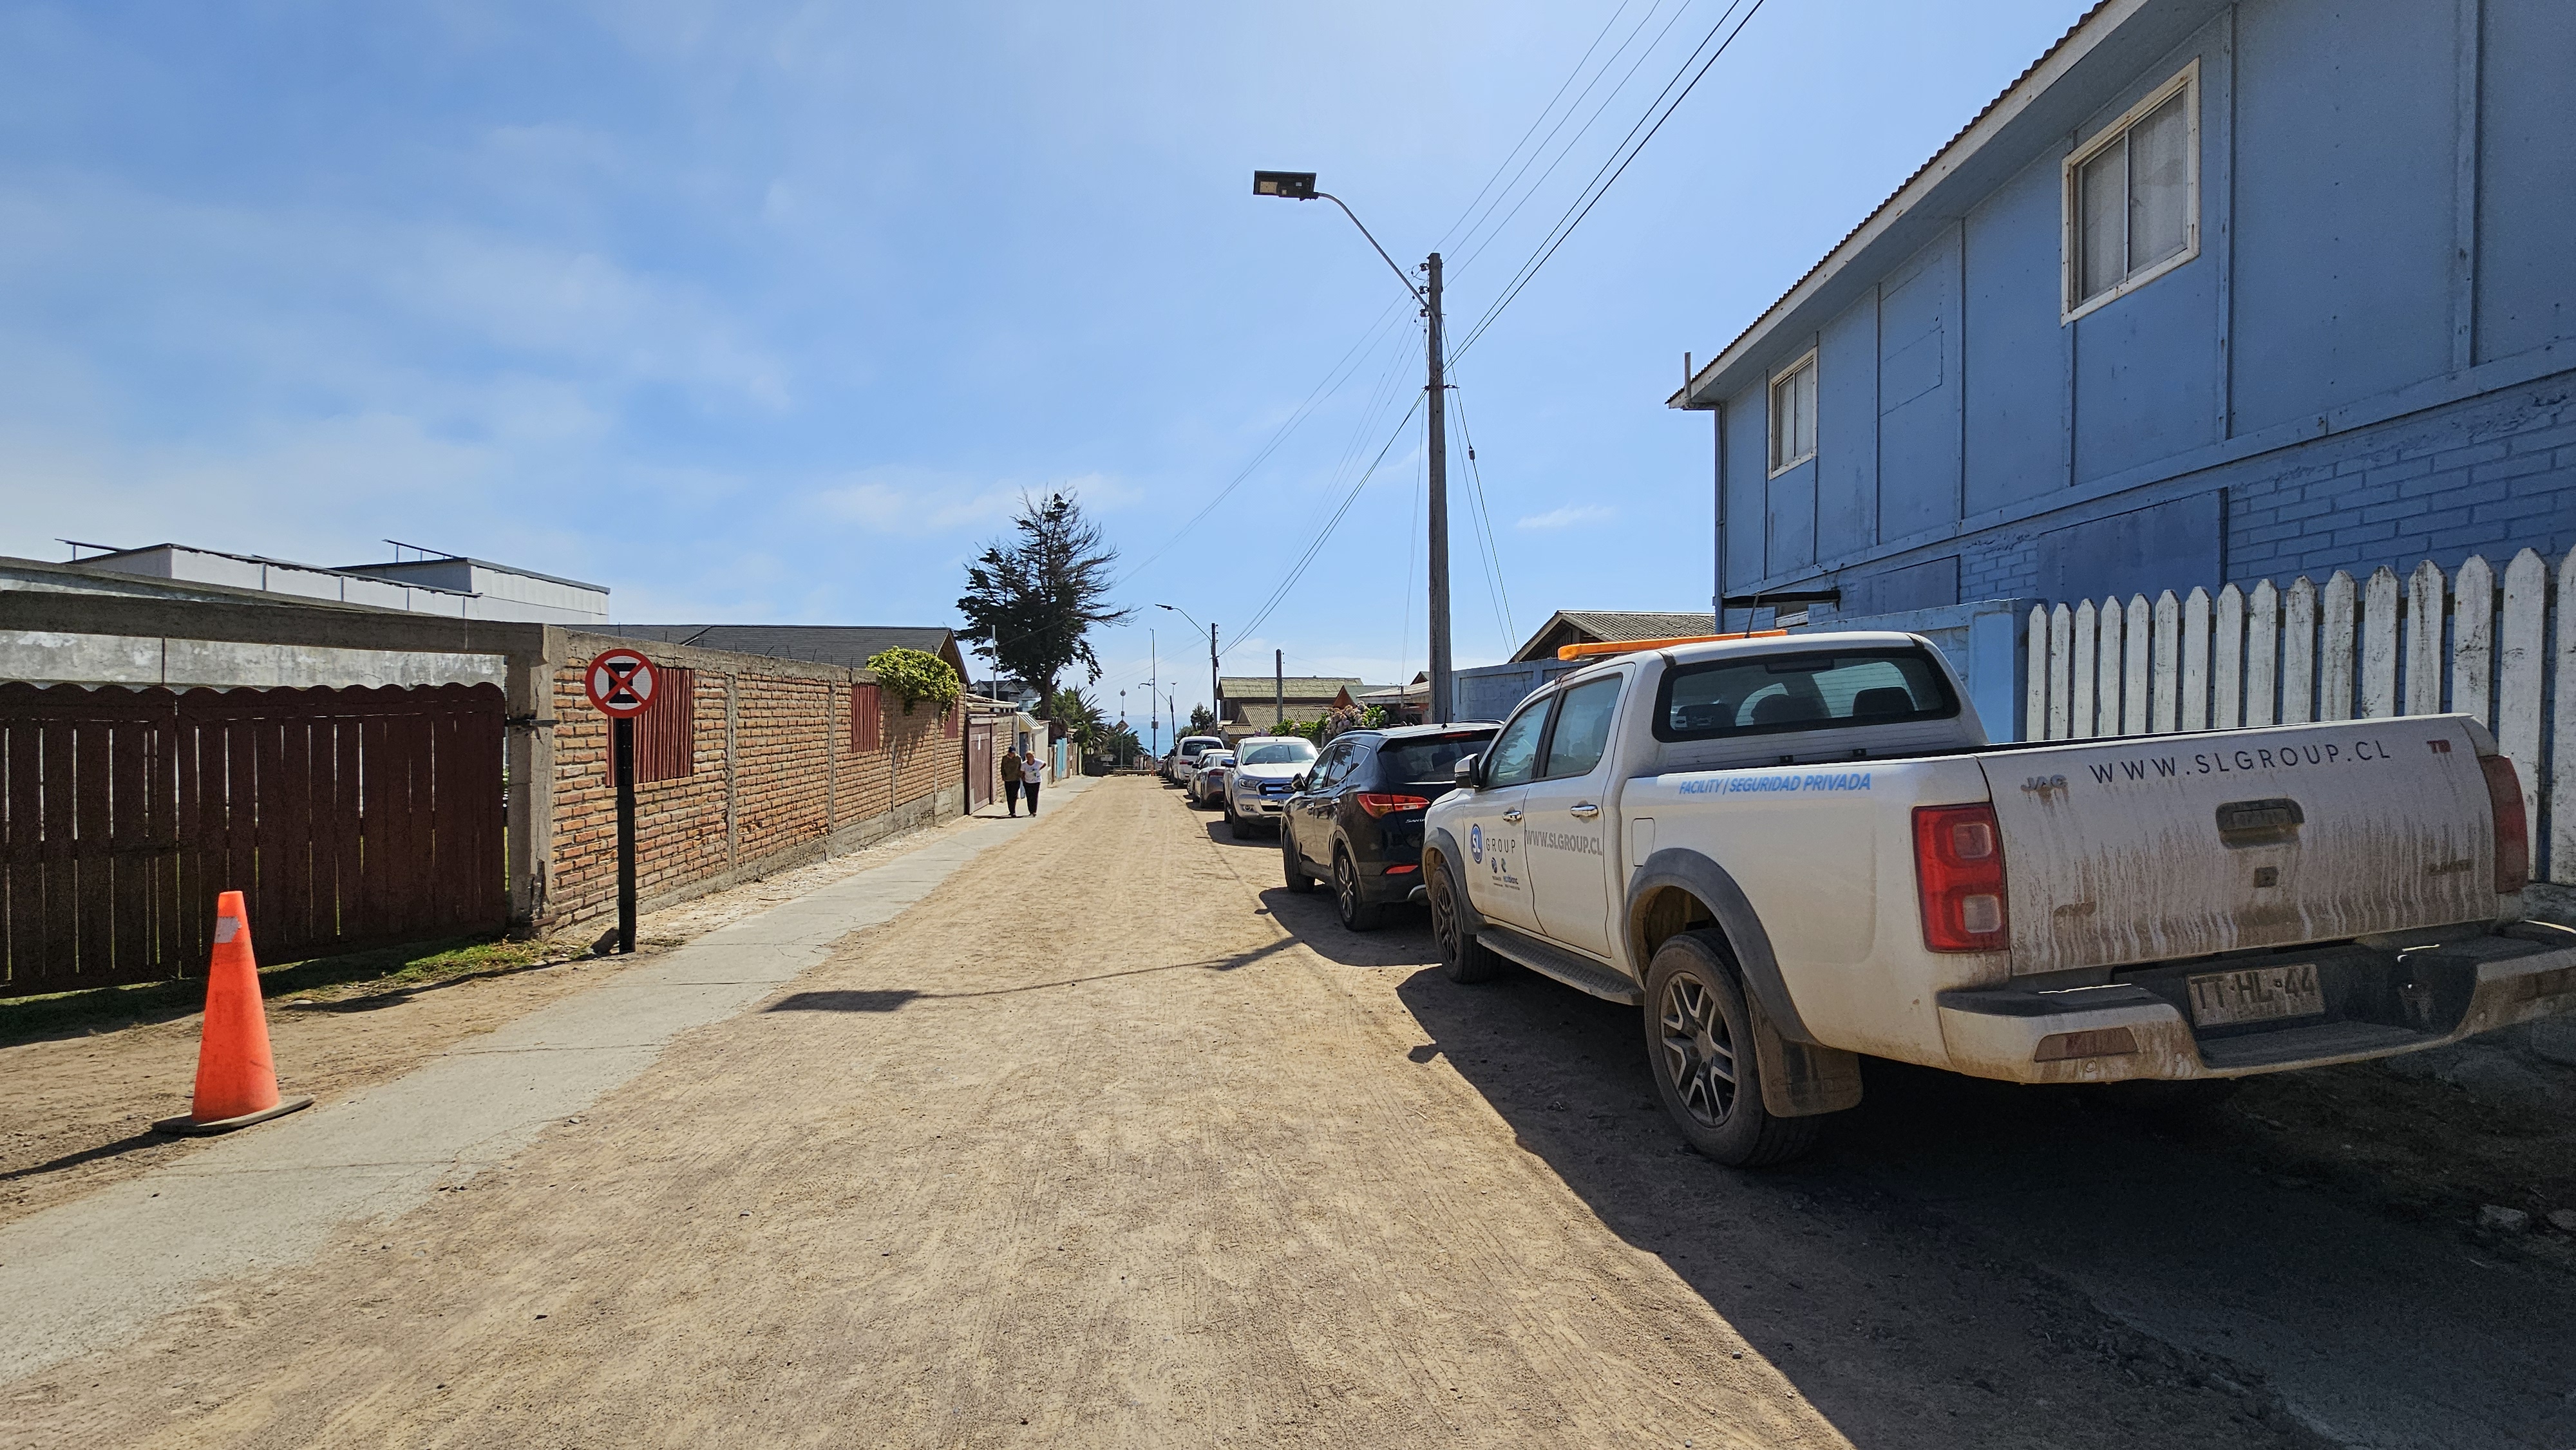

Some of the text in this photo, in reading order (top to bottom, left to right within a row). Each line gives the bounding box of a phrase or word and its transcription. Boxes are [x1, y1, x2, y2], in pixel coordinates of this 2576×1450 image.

[2089, 740, 2390, 784] WWW.SLGROUP.CL
[1679, 778, 1724, 795] FACILITY
[1729, 775, 1801, 793] SEGURIDAD
[1803, 772, 1871, 791] PRIVADA
[1472, 834, 1481, 853] SL
[1486, 838, 1515, 854] GROUP
[1524, 829, 1602, 856] WWW.SLGROUP.CL
